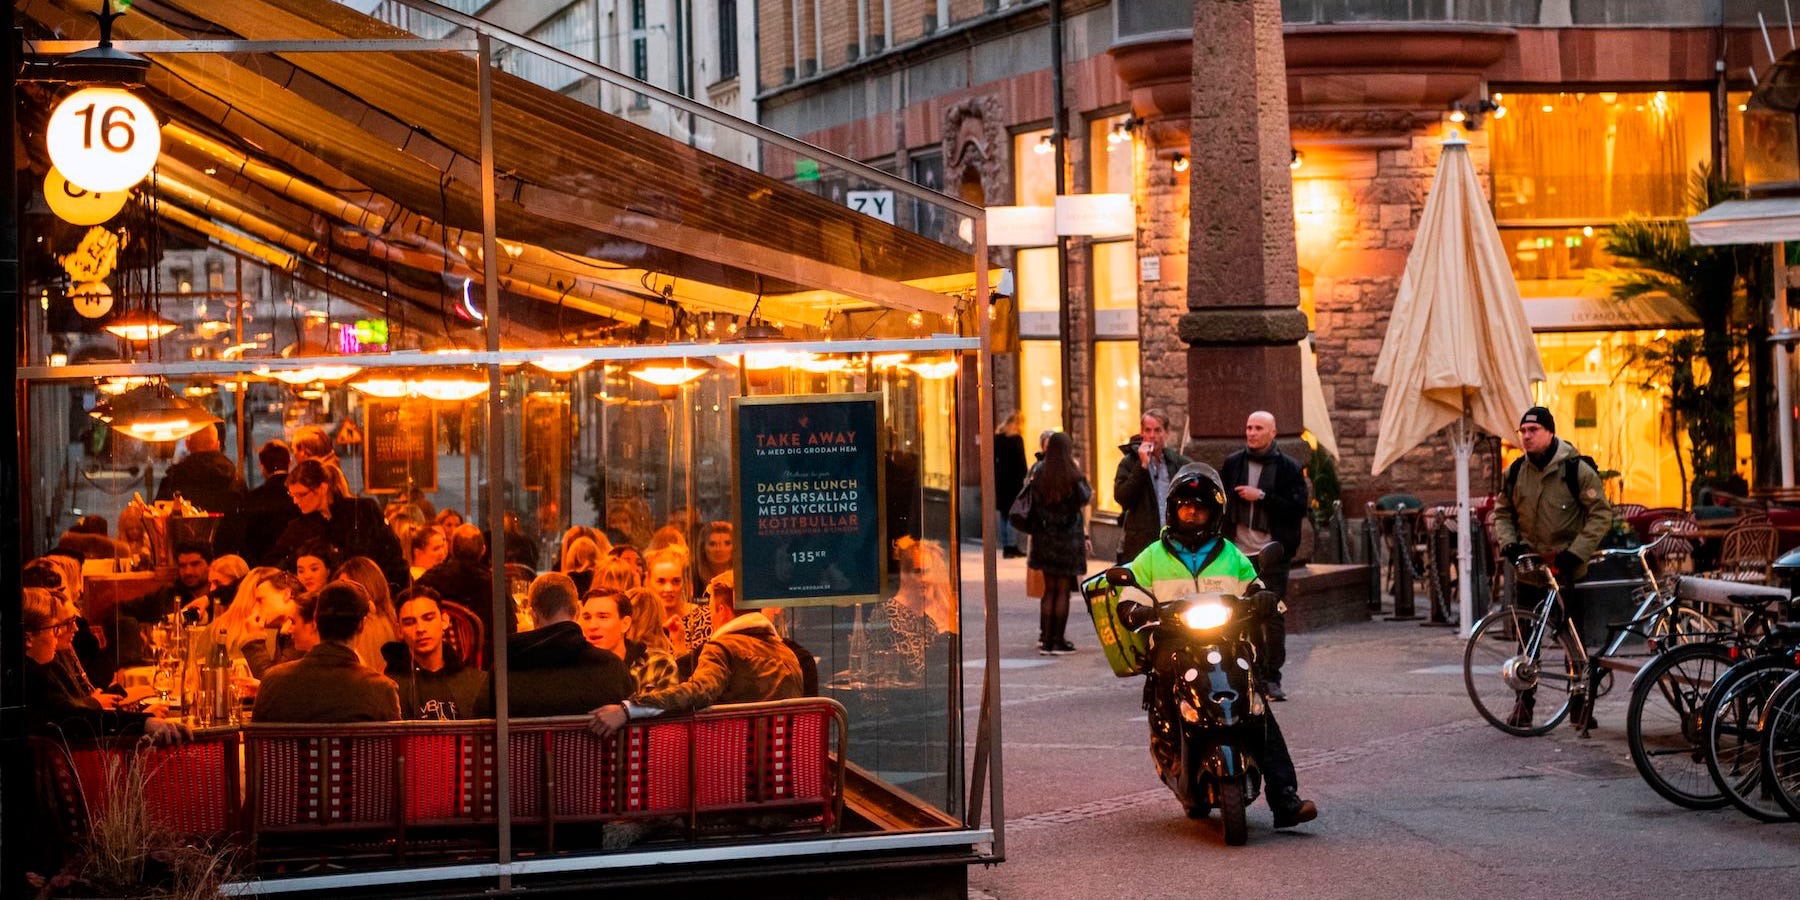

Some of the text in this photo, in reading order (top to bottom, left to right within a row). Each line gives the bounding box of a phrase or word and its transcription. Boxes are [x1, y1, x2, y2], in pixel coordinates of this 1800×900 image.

[74, 103, 137, 153] 16
[756, 431, 857, 447] TAKE AWAY
[756, 445, 858, 456] TA MED DIG GRODAN HEM
[757, 480, 858, 493] DAGENS LUNCH
[757, 490, 858, 505] CAESARSALLAD
[758, 502, 858, 516] MED KYCKLING
